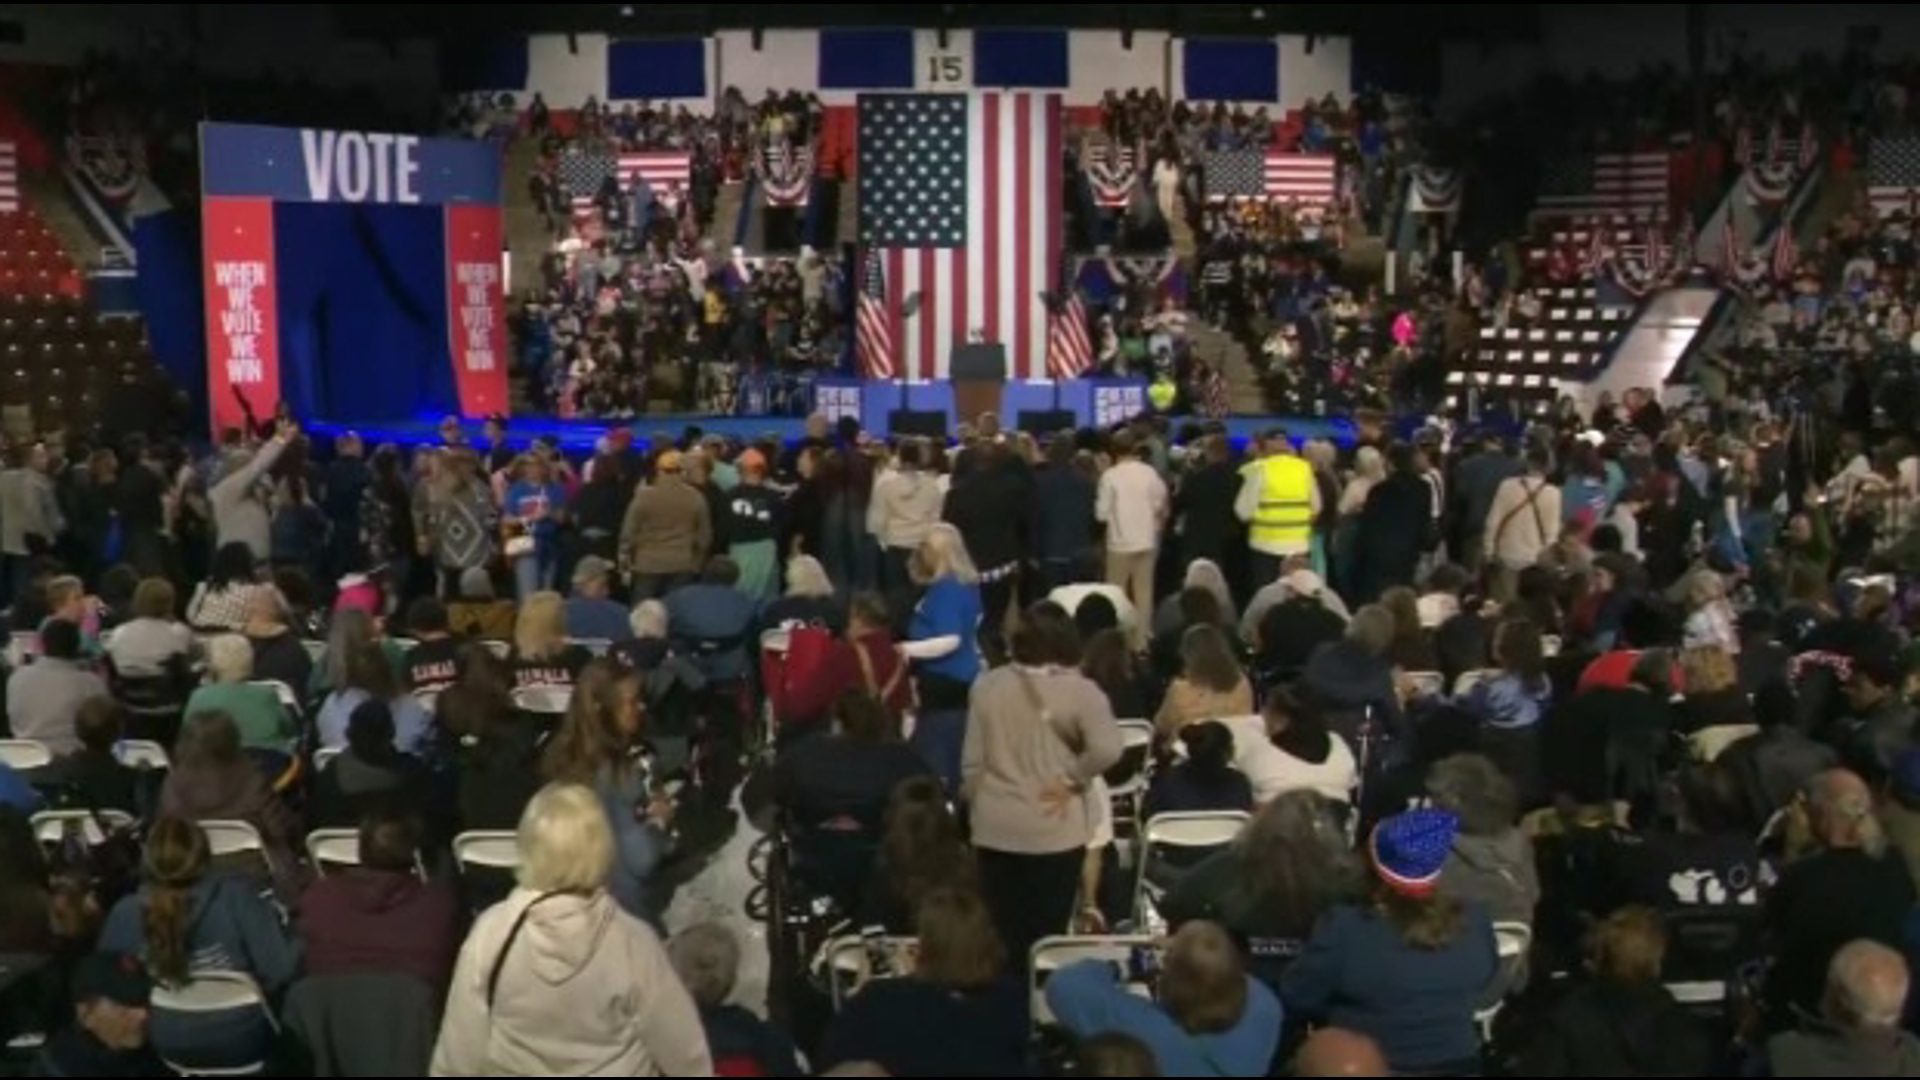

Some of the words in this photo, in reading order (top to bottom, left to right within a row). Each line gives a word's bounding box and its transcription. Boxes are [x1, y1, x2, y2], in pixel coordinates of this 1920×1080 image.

[929, 56, 962, 82] 15
[302, 129, 420, 203] VOTE
[214, 262, 266, 287] WHEN
[227, 287, 254, 310] WE
[220, 310, 262, 335] VOTE
[229, 335, 257, 357] WE
[226, 359, 264, 383] WIN
